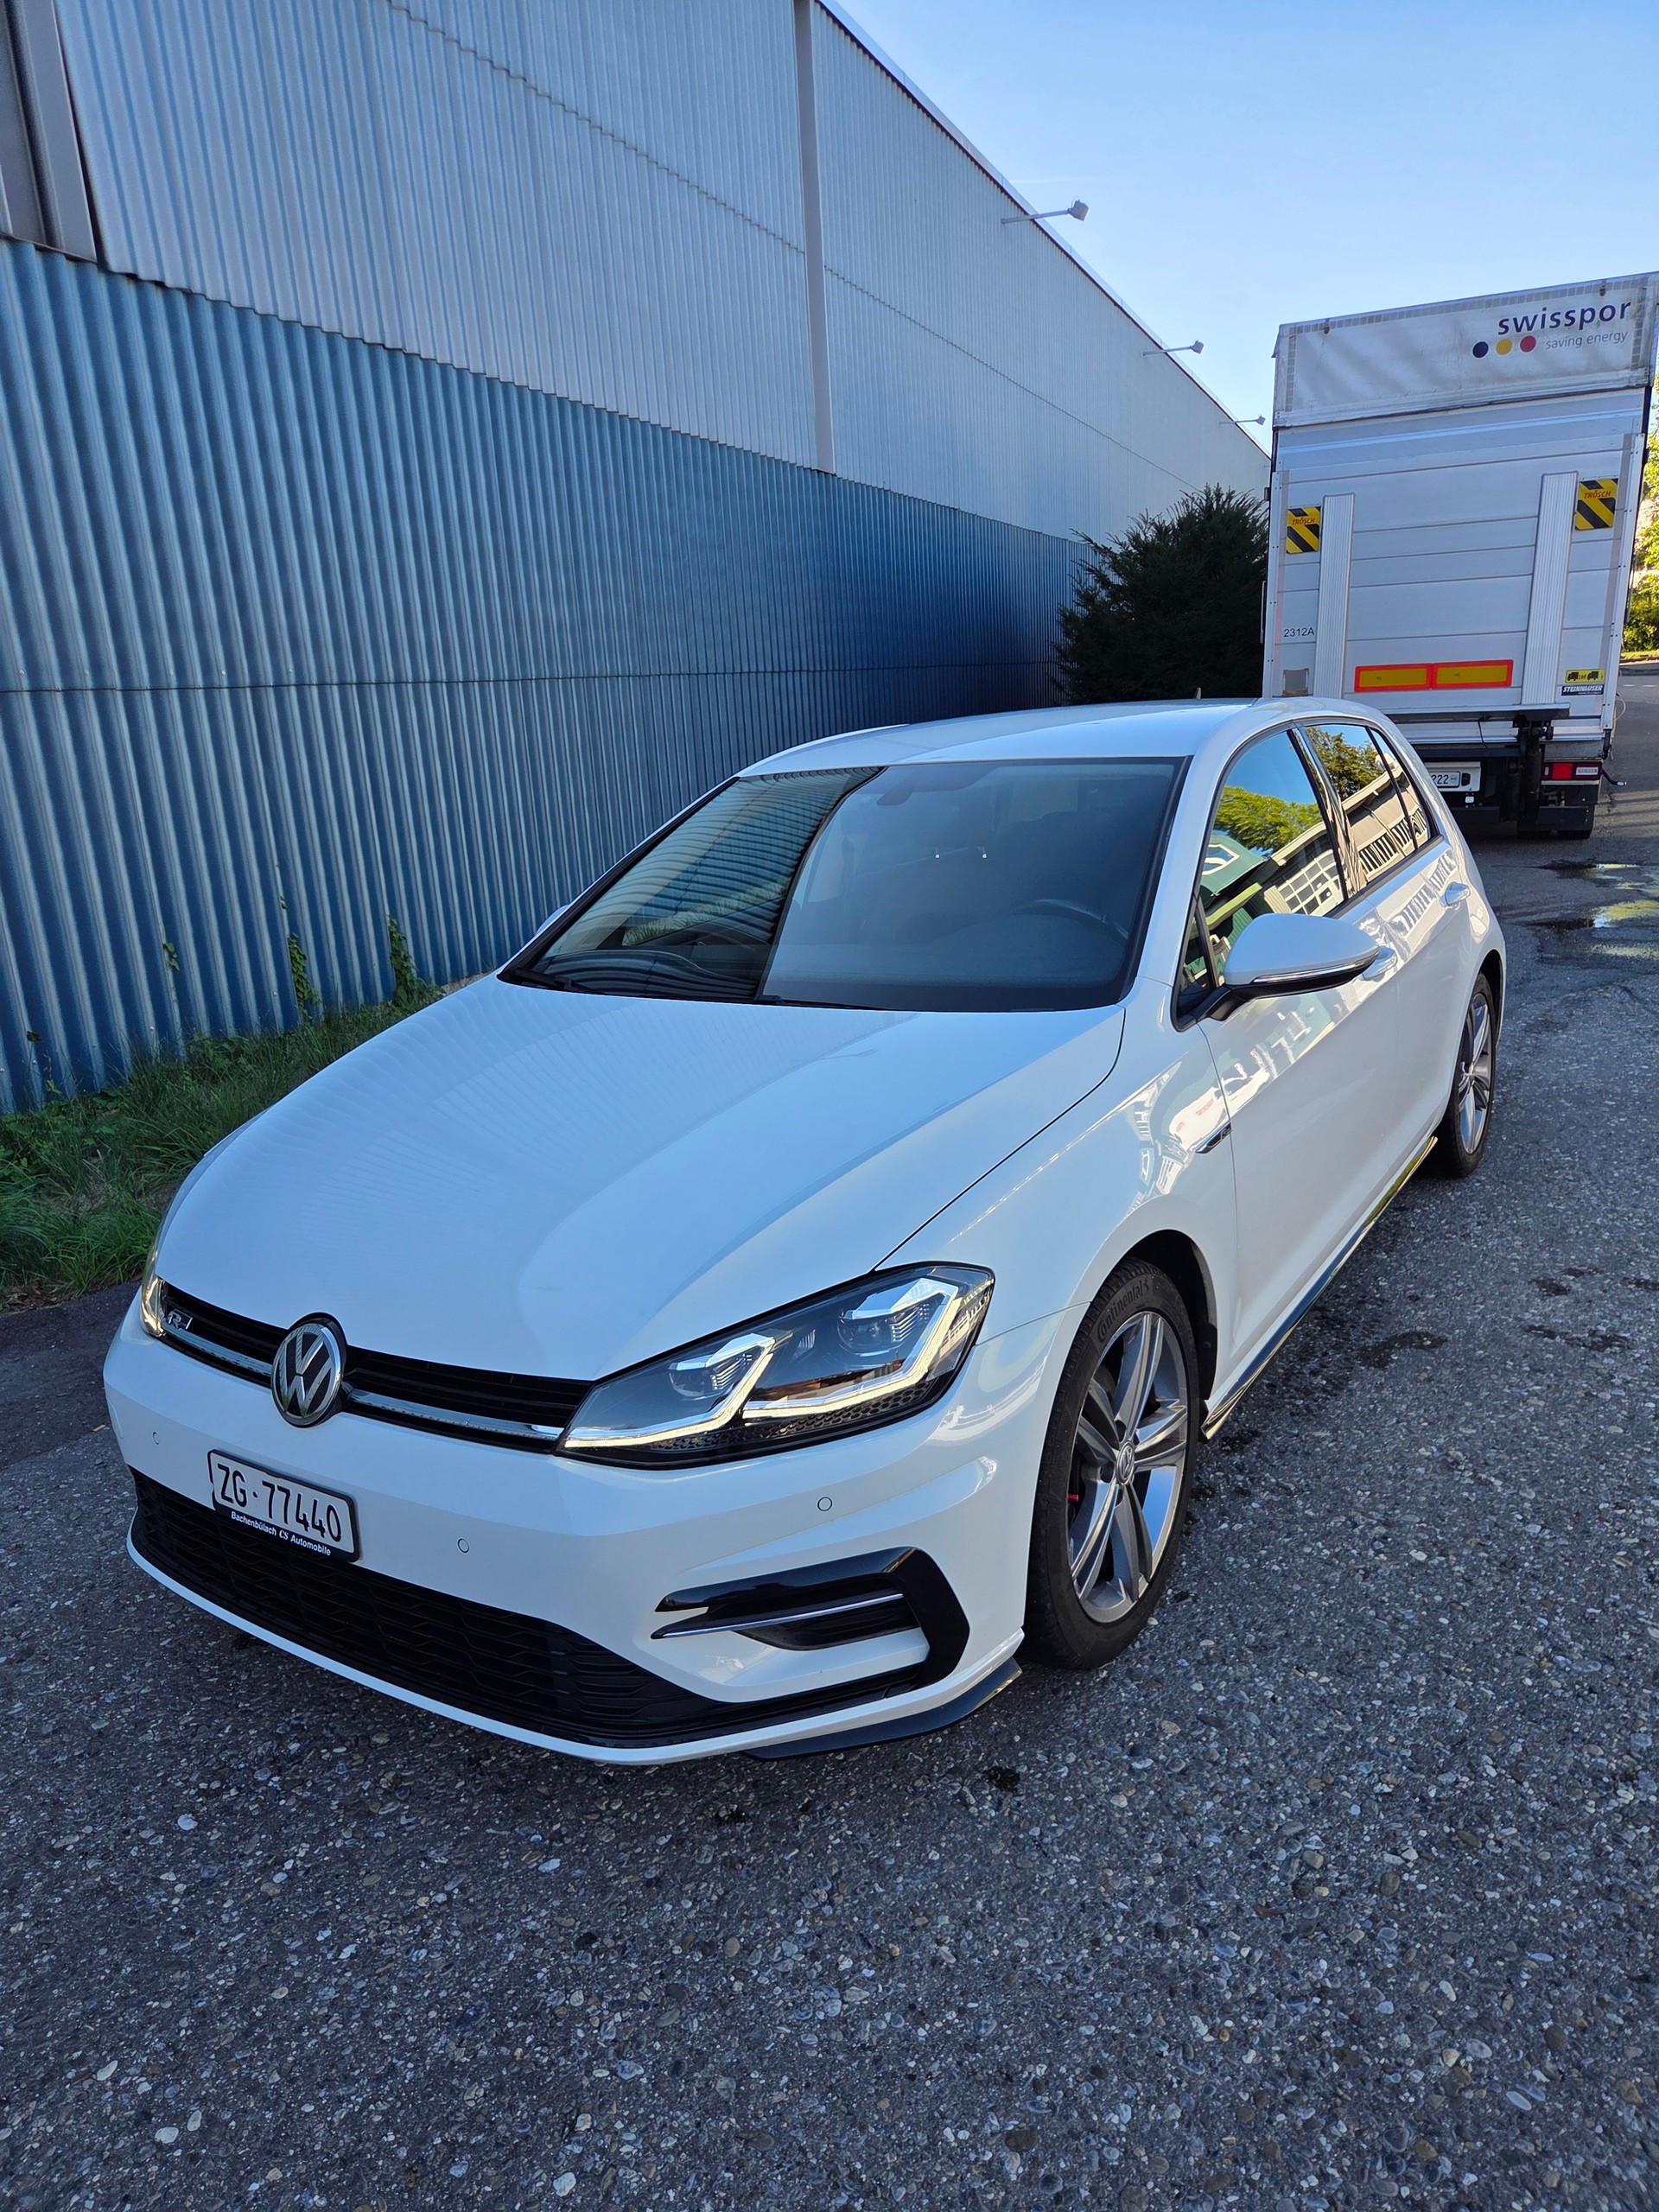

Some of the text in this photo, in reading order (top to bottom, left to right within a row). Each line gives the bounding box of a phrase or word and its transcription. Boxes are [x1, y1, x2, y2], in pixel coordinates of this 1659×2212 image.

[1497, 302, 1631, 335] swisspor
[1546, 331, 1629, 350] saving energy
[1584, 490, 1611, 499] TRÖSCH
[1283, 626, 1315, 638] 2312A
[231, 1510, 276, 1536] Bachenbülach
[290, 1535, 331, 1556] Automobile
